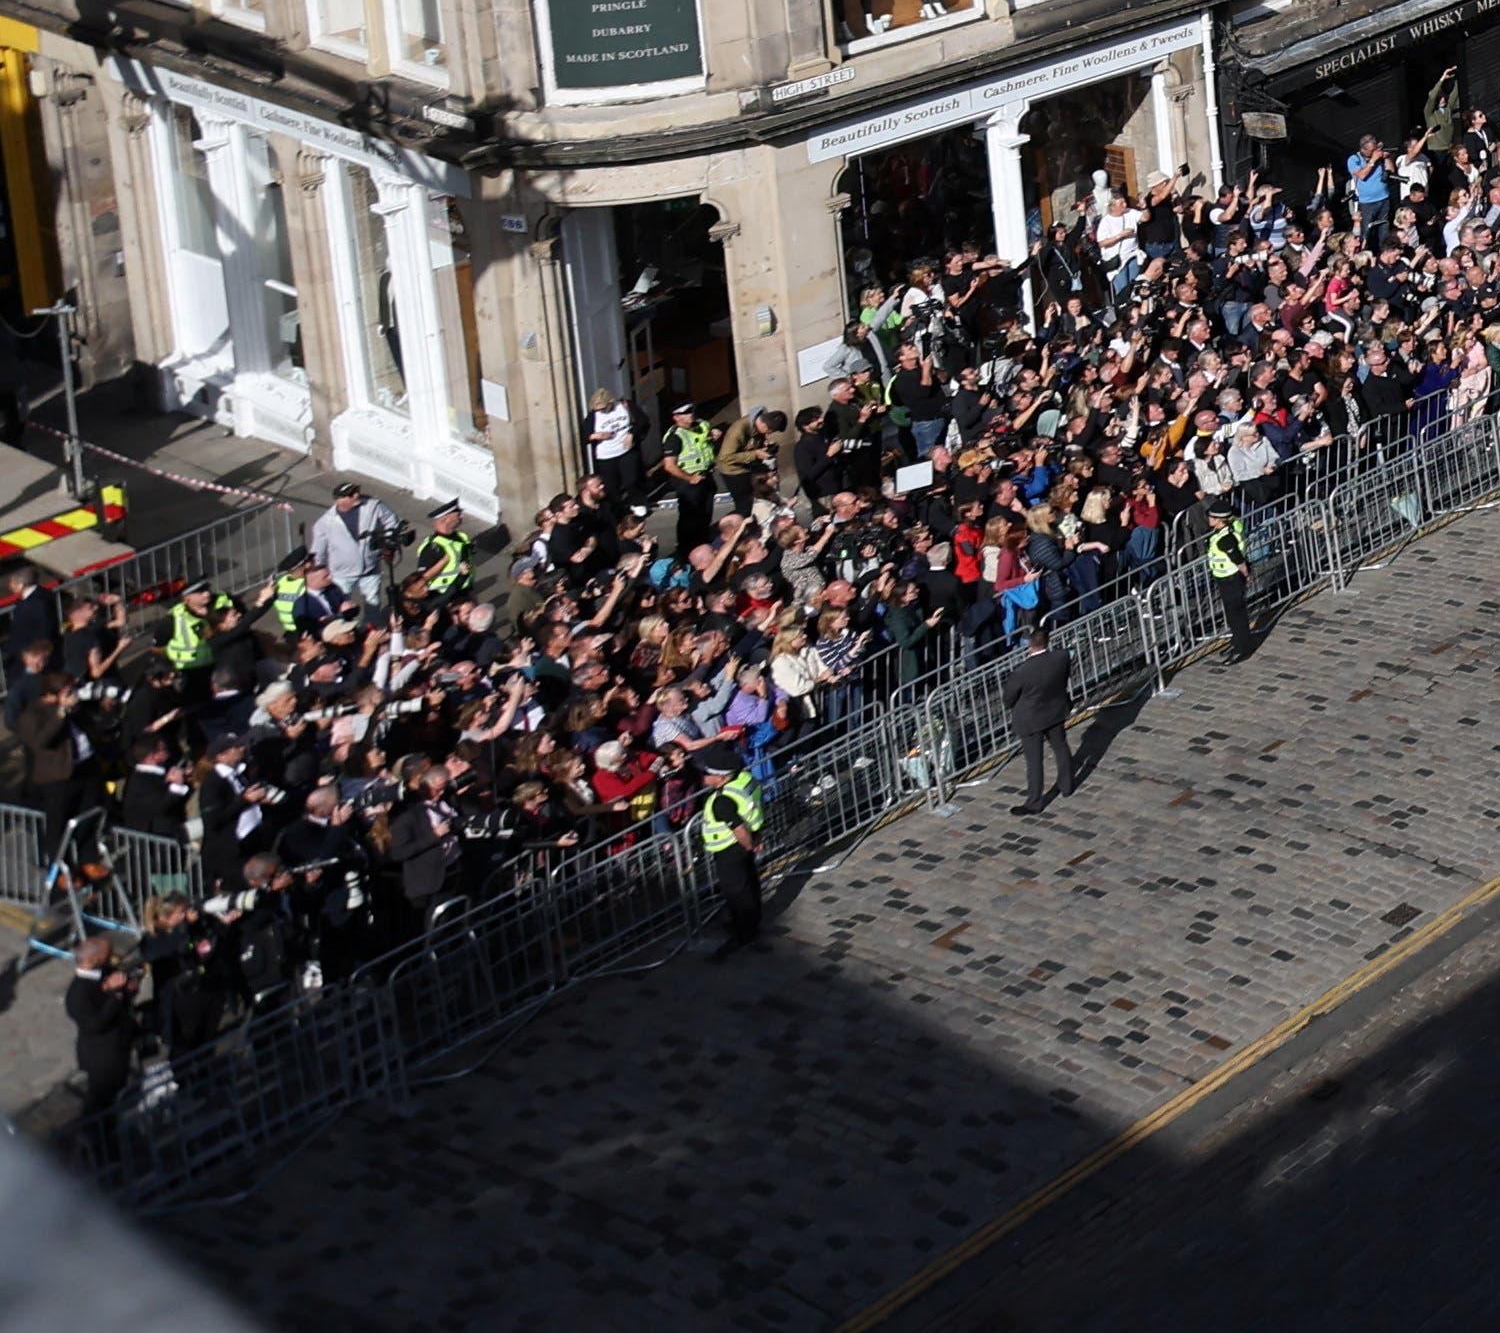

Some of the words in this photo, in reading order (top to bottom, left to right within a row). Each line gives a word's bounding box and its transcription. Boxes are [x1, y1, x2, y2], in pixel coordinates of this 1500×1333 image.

[591, 0, 647, 13] PRINGLE
[592, 24, 652, 38] DUBARRY
[1315, 34, 1398, 79] SPECIALIST
[1408, 7, 1465, 40] WHISKY
[566, 53, 599, 63] MADE
[602, 52, 616, 61] IN
[618, 43, 689, 60] SCOTLAND
[775, 85, 804, 100] HIGH
[810, 69, 853, 89] STREET
[820, 116, 901, 150] Beautifully
[903, 99, 960, 124] Scottish
[1052, 64, 1079, 79] Fine
[1082, 46, 1137, 68] Woollens
[1139, 41, 1149, 51] &
[1150, 28, 1194, 48] Tweeds
